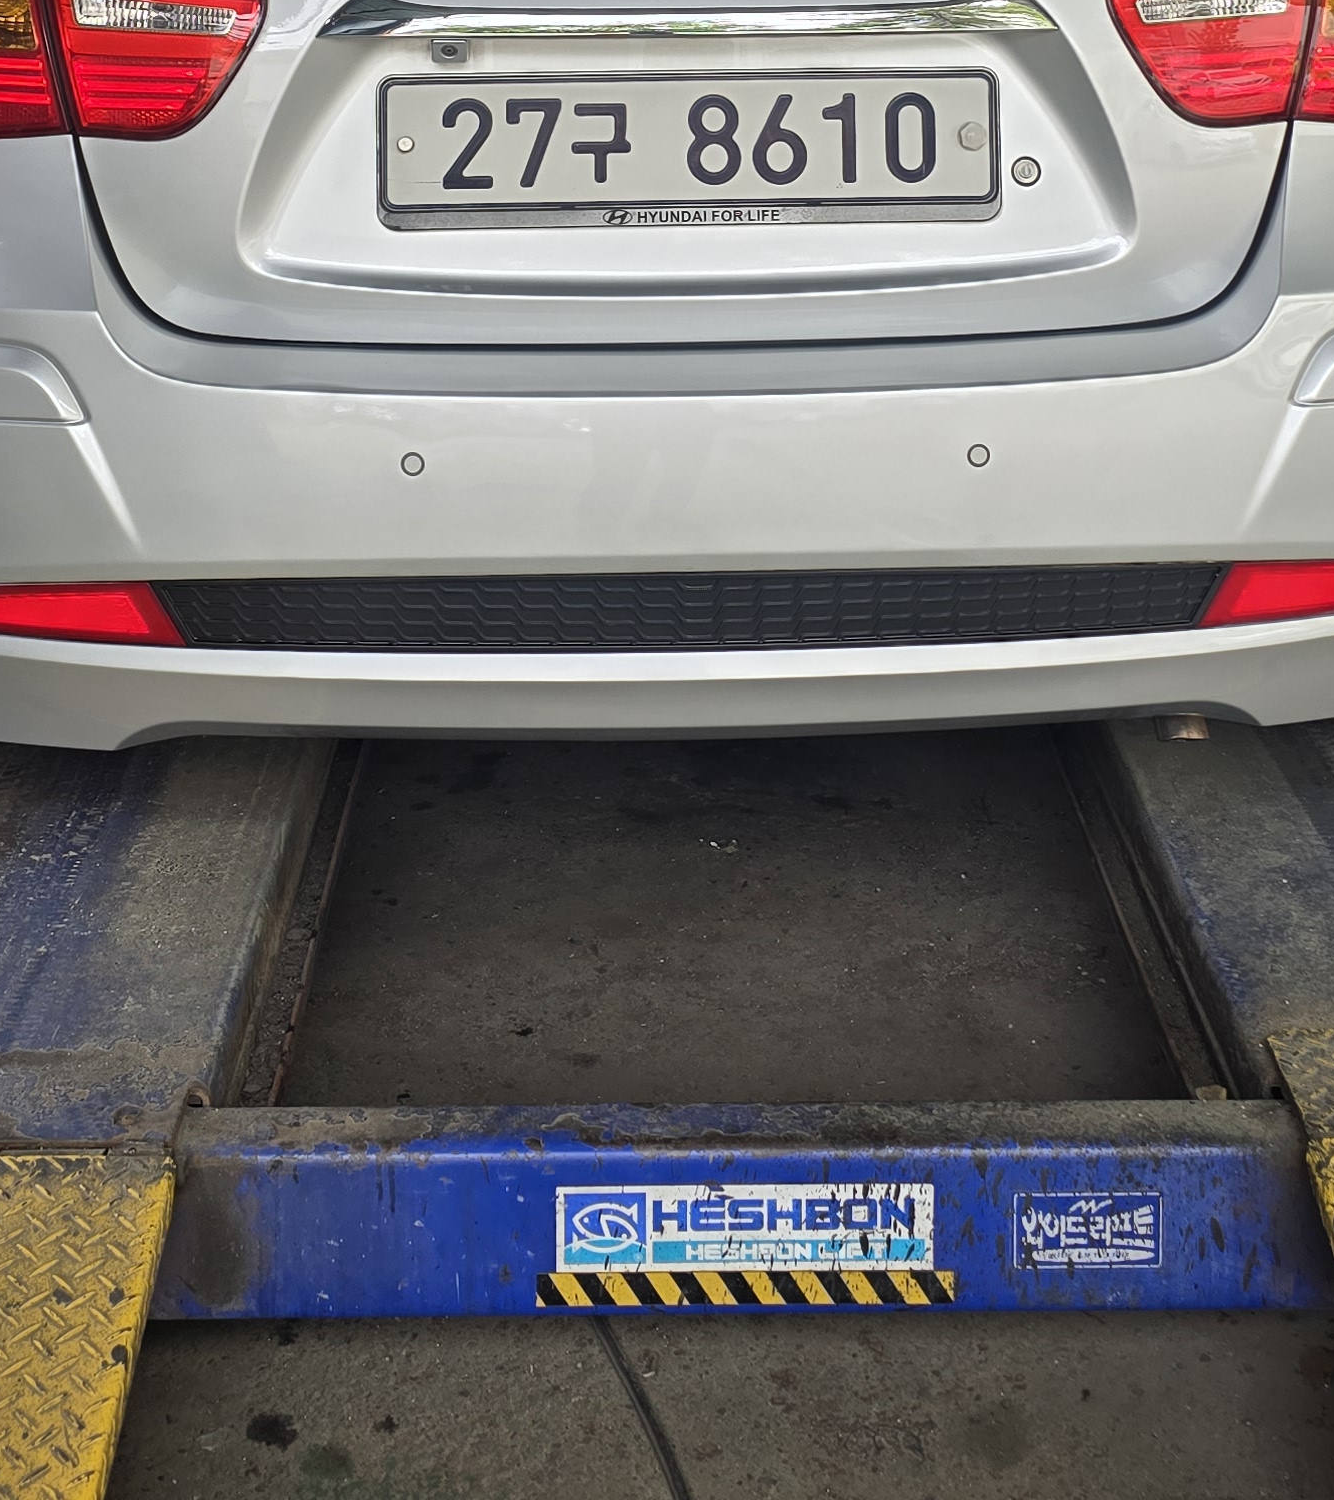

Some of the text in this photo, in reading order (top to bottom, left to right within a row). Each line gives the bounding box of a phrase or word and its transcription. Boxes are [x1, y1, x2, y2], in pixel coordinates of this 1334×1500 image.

[441, 91, 937, 190] 27구 8610
[637, 209, 780, 223] HYUNDAI FOR LIFE
[652, 1198, 917, 1233] HESHBON
